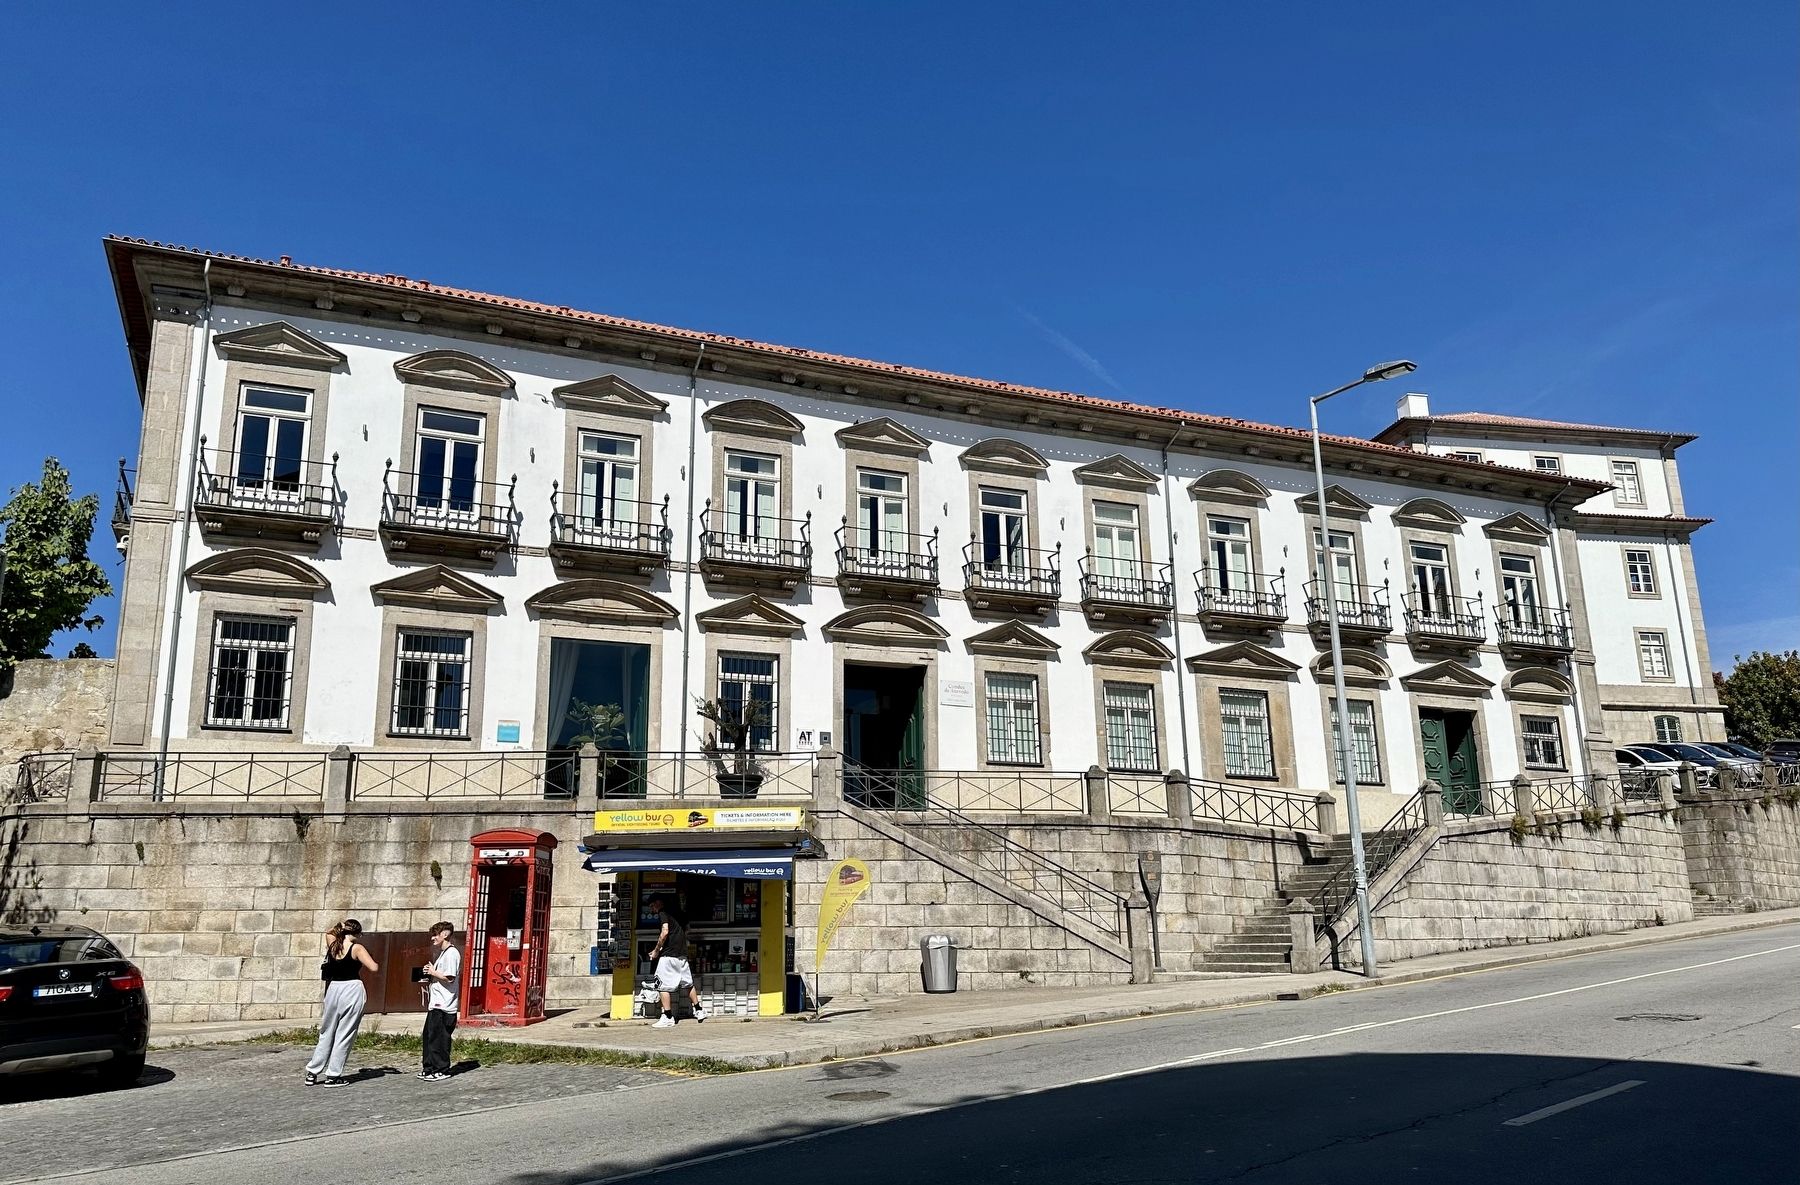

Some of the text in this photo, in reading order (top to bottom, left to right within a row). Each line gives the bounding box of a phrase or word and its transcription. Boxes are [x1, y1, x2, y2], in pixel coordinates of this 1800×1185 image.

[799, 731, 813, 742] AT
[609, 812, 661, 822] yellow bus
